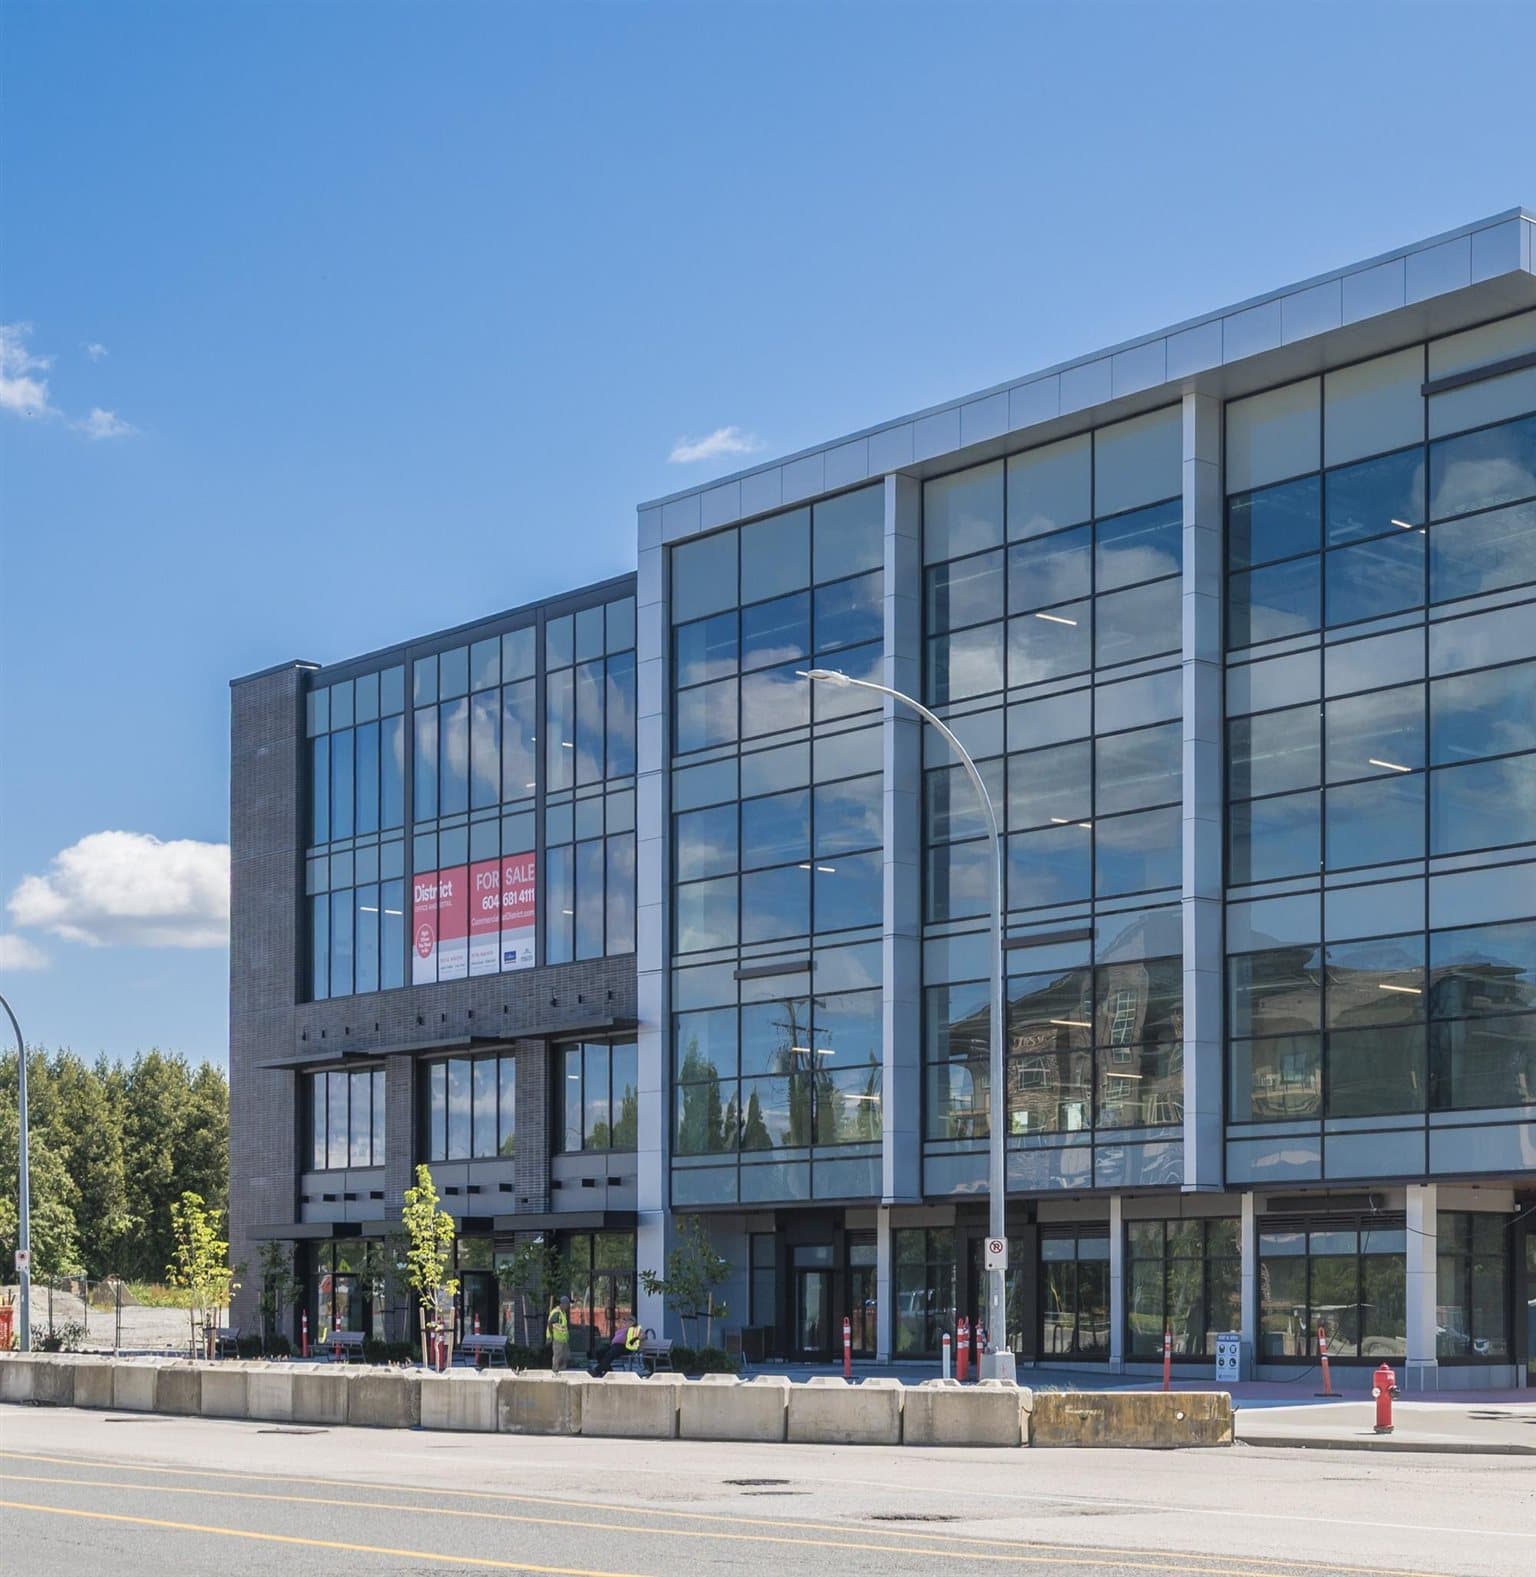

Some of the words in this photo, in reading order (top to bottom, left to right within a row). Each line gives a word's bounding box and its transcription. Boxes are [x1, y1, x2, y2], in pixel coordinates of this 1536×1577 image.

[476, 870, 499, 891] FOR
[506, 863, 535, 885] SALE
[414, 880, 452, 903] District
[482, 894, 500, 910] 604
[502, 890, 517, 906] 681
[518, 887, 535, 903] 4111
